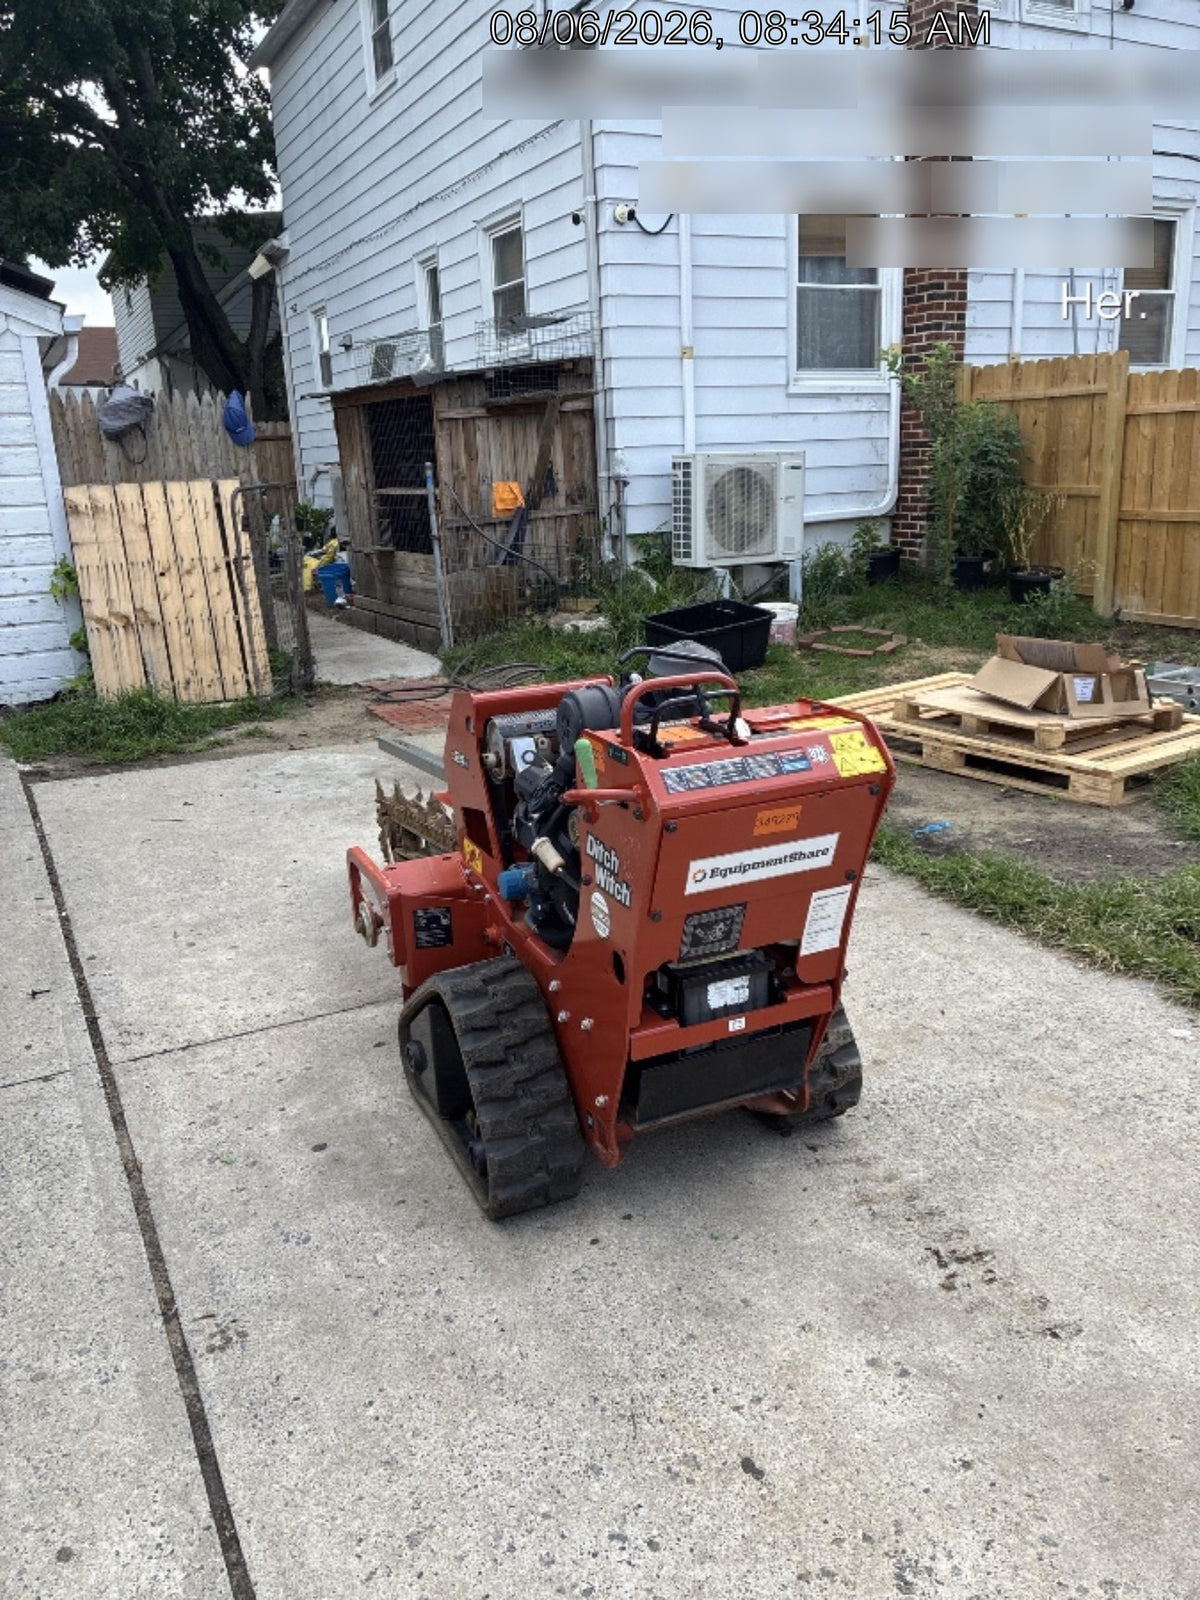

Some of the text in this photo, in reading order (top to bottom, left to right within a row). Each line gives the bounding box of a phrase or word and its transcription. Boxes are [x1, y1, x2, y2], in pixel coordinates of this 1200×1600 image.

[586, 832, 619, 875] Ditch
[709, 847, 829, 879] EquipmentShare
[595, 862, 631, 907] Witch
